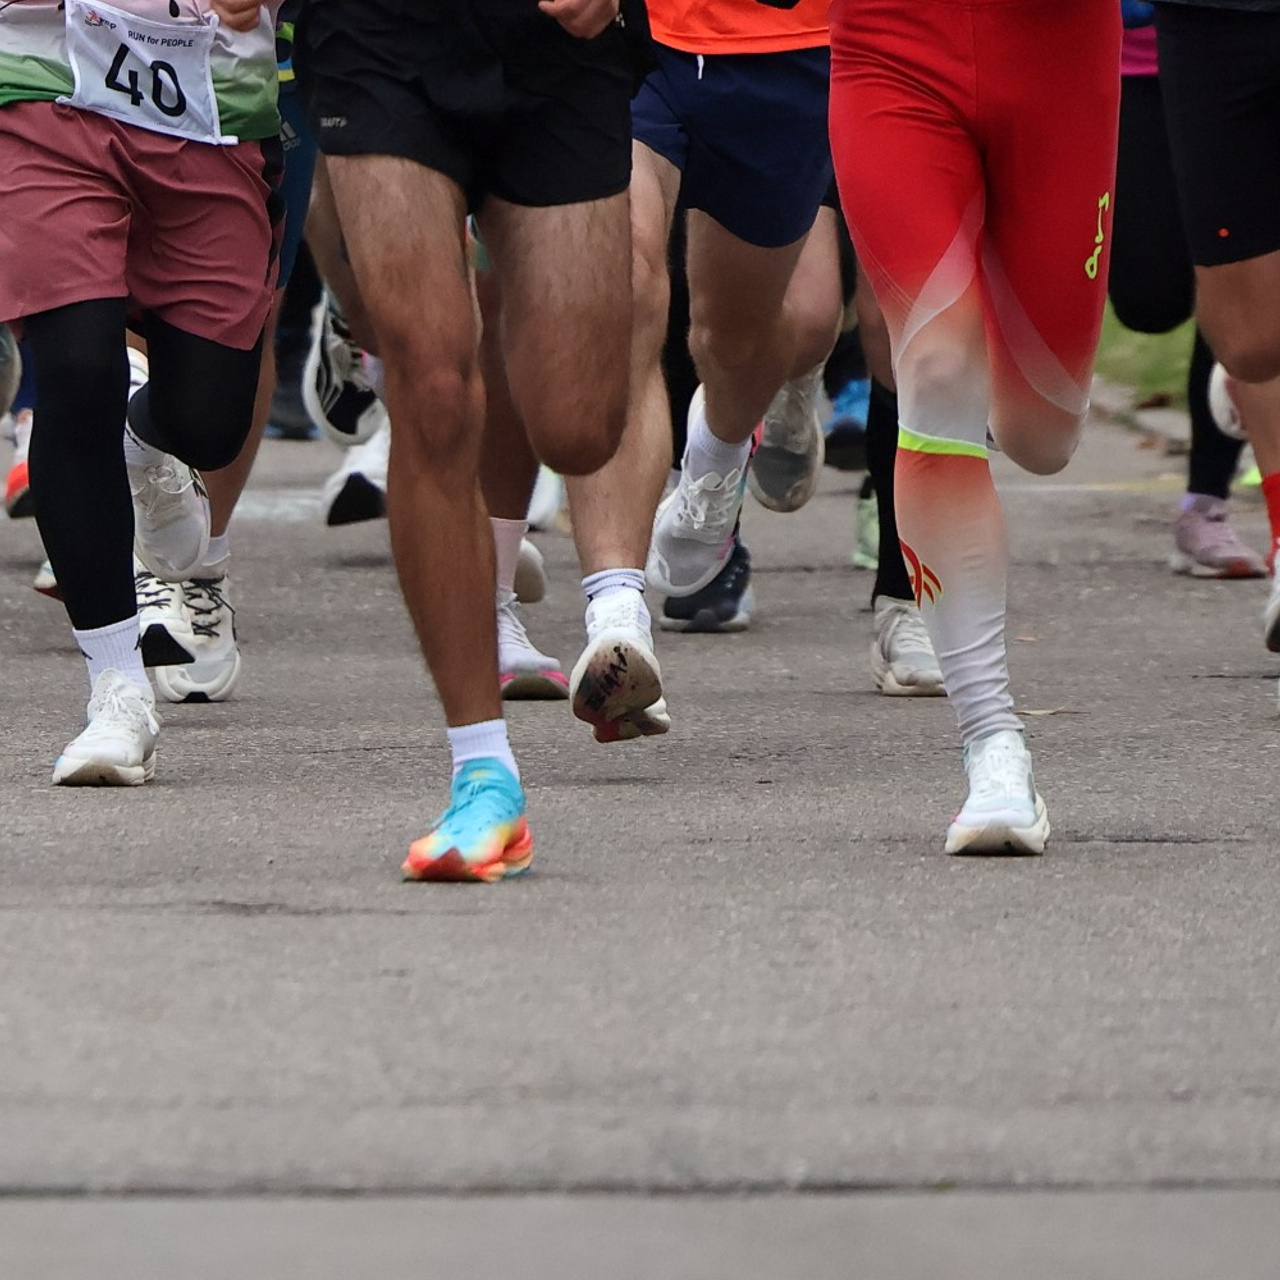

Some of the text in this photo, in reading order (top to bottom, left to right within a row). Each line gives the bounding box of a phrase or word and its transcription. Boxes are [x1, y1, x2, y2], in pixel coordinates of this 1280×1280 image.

[128, 30, 145, 42] RUN
[147, 35, 159, 45] for
[160, 38, 194, 48] PEOPLE
[105, 43, 186, 117] 40
